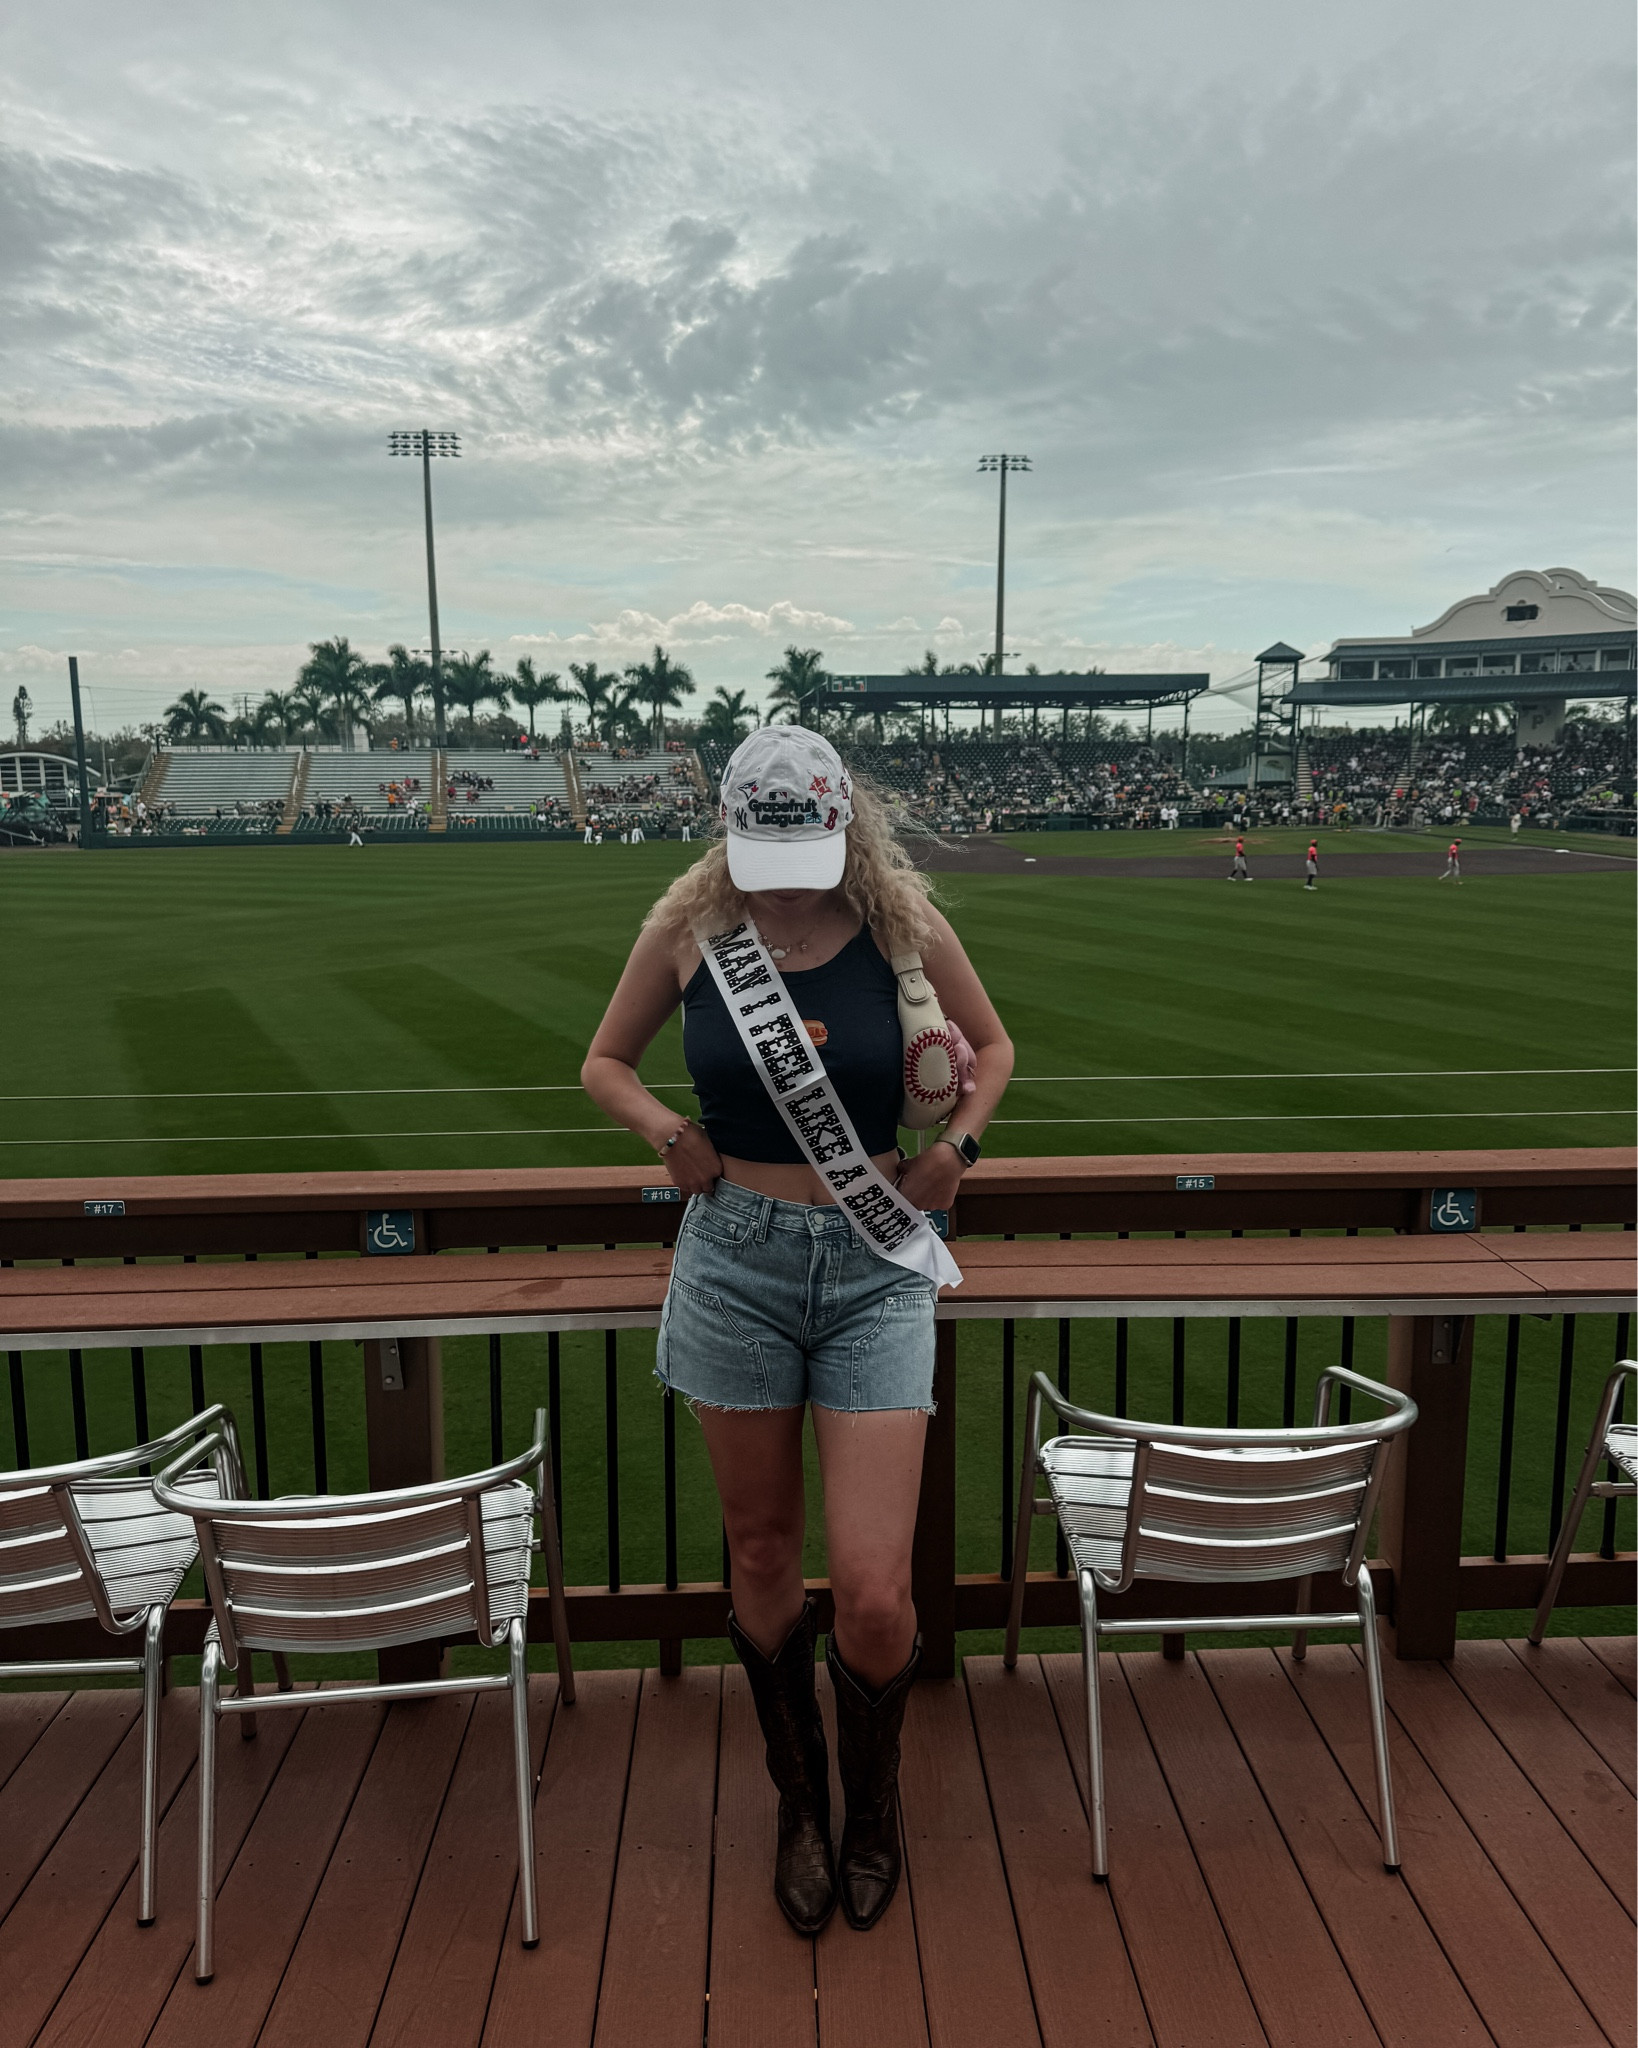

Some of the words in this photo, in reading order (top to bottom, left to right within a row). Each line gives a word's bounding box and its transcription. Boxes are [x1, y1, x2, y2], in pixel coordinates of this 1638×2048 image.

[734, 806, 749, 831] NY
[748, 798, 818, 814] Grapefruit
[823, 806, 839, 831] B
[756, 811, 806, 828] League
[708, 922, 773, 995] MAN
[739, 991, 782, 1017] I
[748, 1012, 815, 1095] FEEL
[784, 1086, 854, 1165] LIKE
[825, 1164, 868, 1191] A
[1185, 1178, 1206, 1189] #15
[650, 1190, 671, 1201] #16
[93, 1203, 115, 1215] #17
